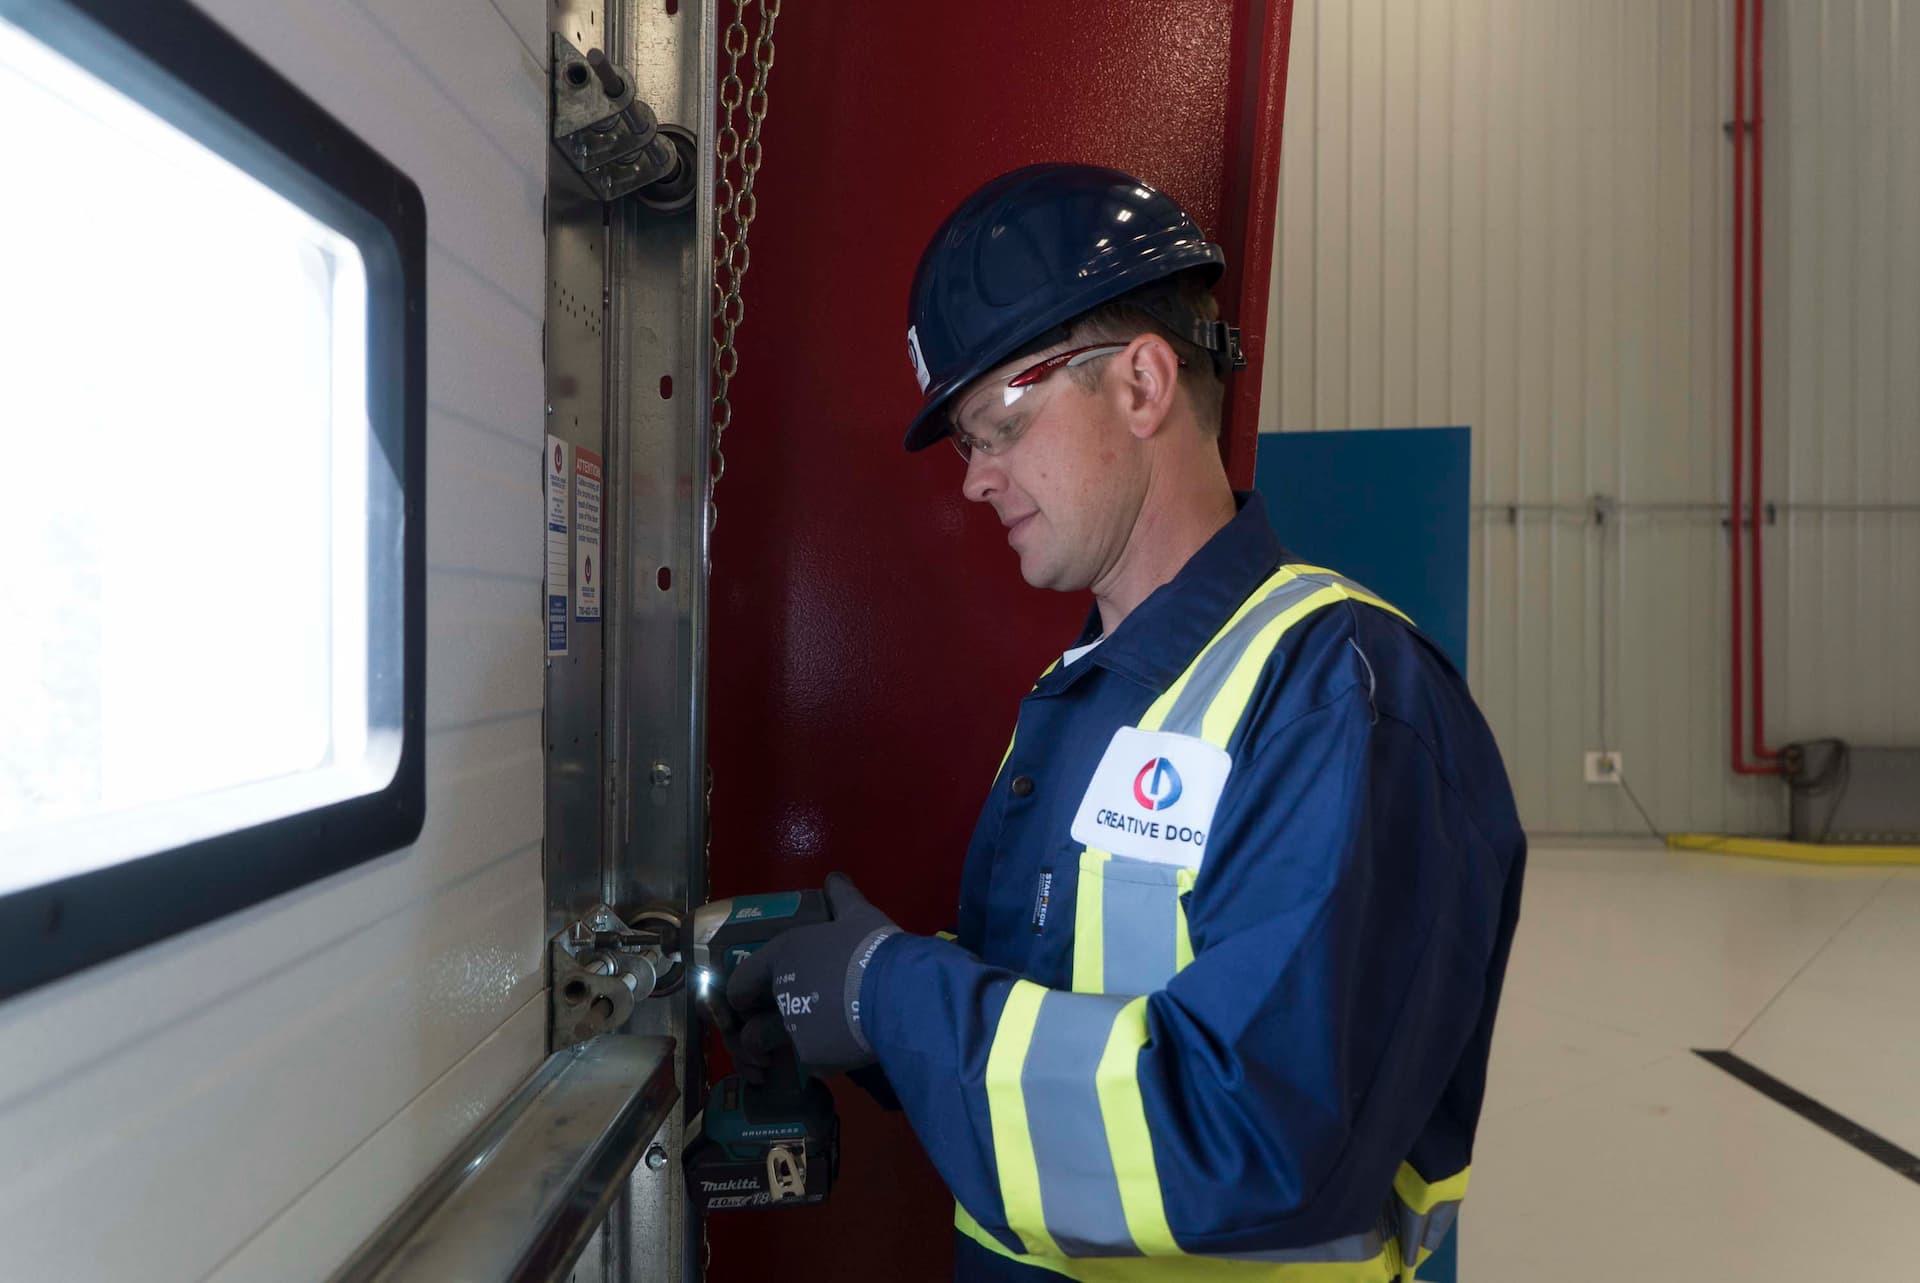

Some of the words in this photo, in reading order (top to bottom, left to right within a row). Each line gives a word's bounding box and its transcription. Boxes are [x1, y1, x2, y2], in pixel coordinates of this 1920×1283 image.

[1096, 809, 1160, 839] CREATIVE
[858, 933, 889, 969] Ansell
[742, 1128, 799, 1137] BRUSHLESS
